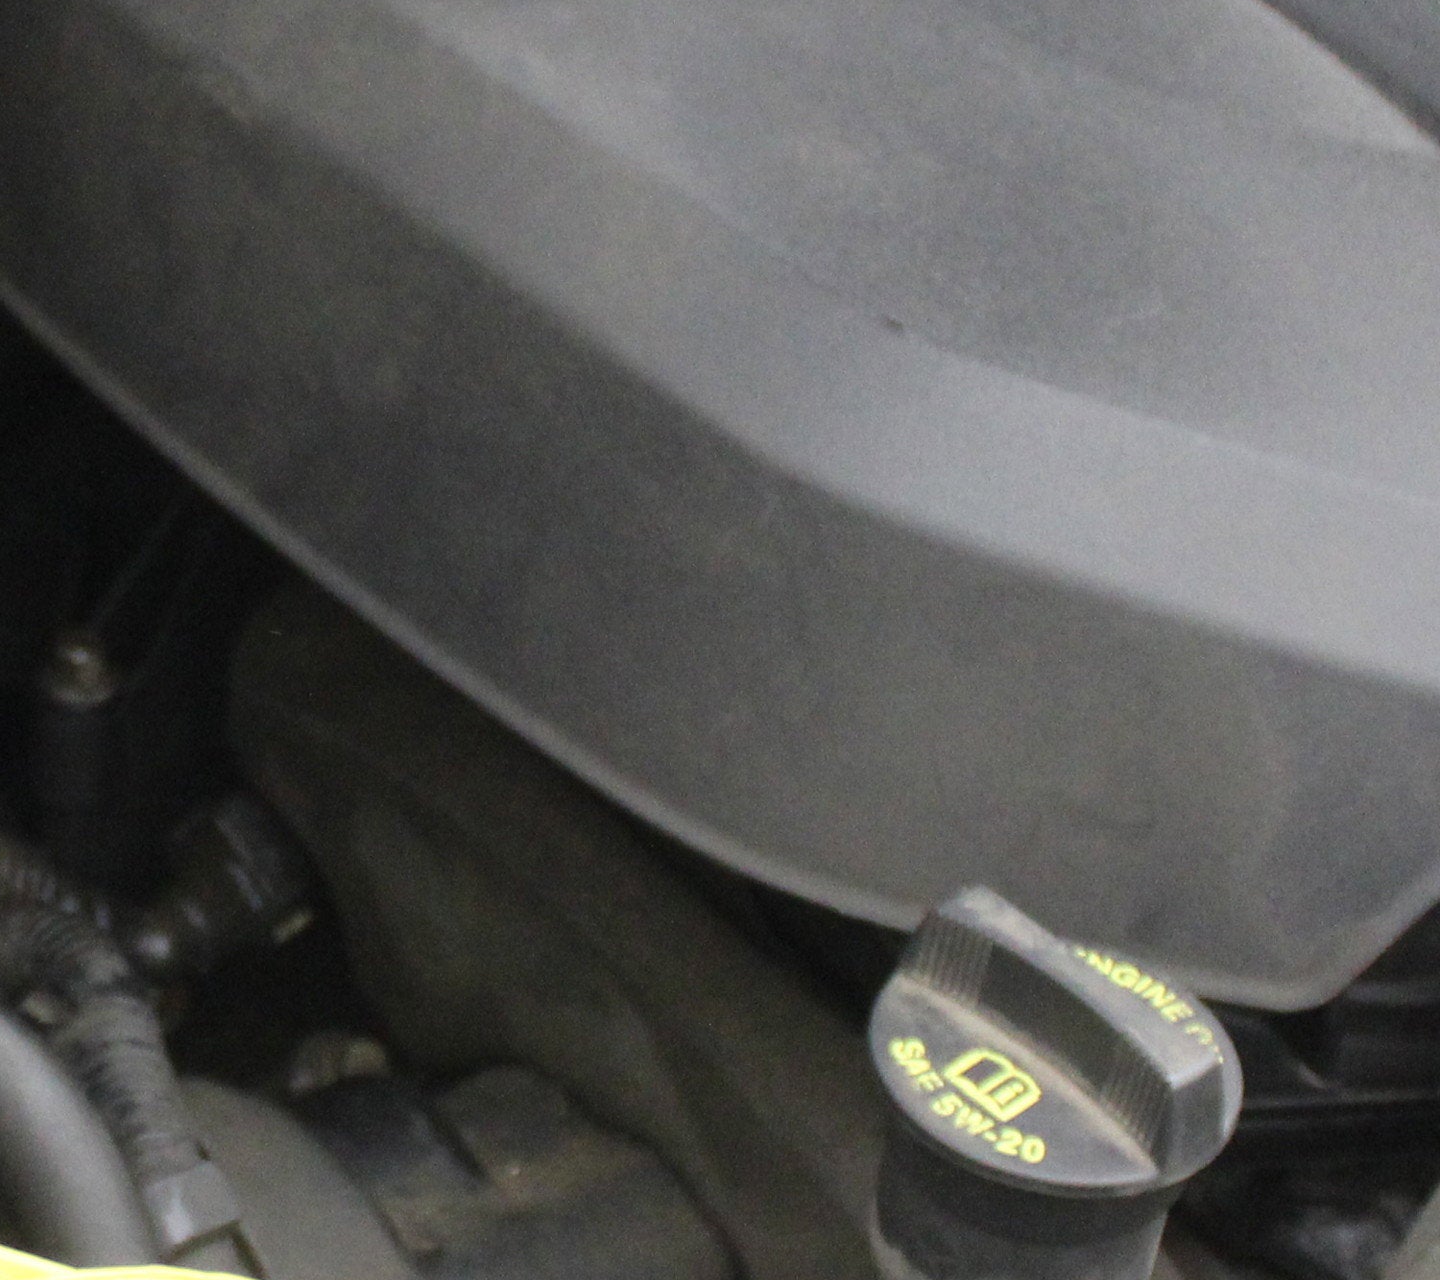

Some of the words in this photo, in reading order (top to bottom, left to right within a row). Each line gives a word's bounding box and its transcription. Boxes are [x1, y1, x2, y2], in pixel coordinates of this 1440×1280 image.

[1073, 945, 1194, 1023] NGINE
[887, 1036, 946, 1092] SAE
[931, 1094, 1047, 1164] 5W-20
